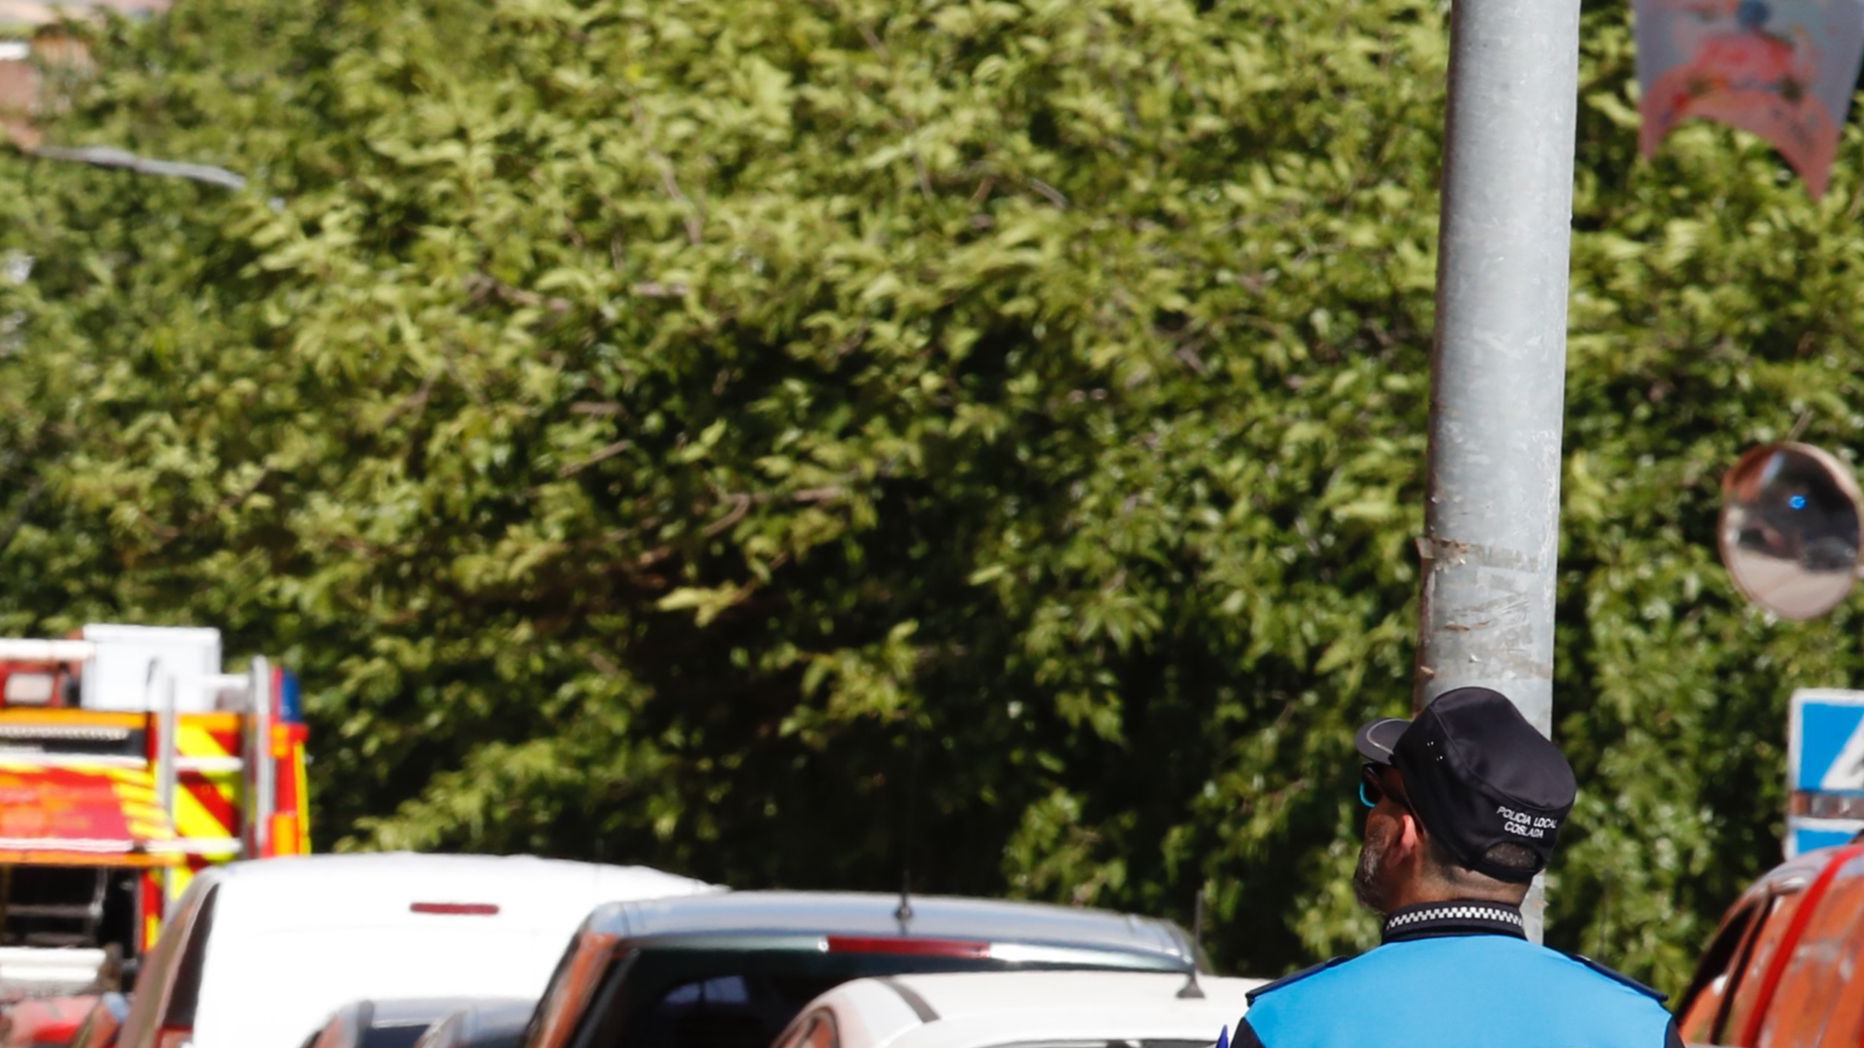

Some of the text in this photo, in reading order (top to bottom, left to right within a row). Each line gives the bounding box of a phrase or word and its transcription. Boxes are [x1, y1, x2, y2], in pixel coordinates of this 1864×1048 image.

[1496, 806, 1557, 829] POLICIA LOCAL
[1504, 822, 1544, 838] COSLADA
